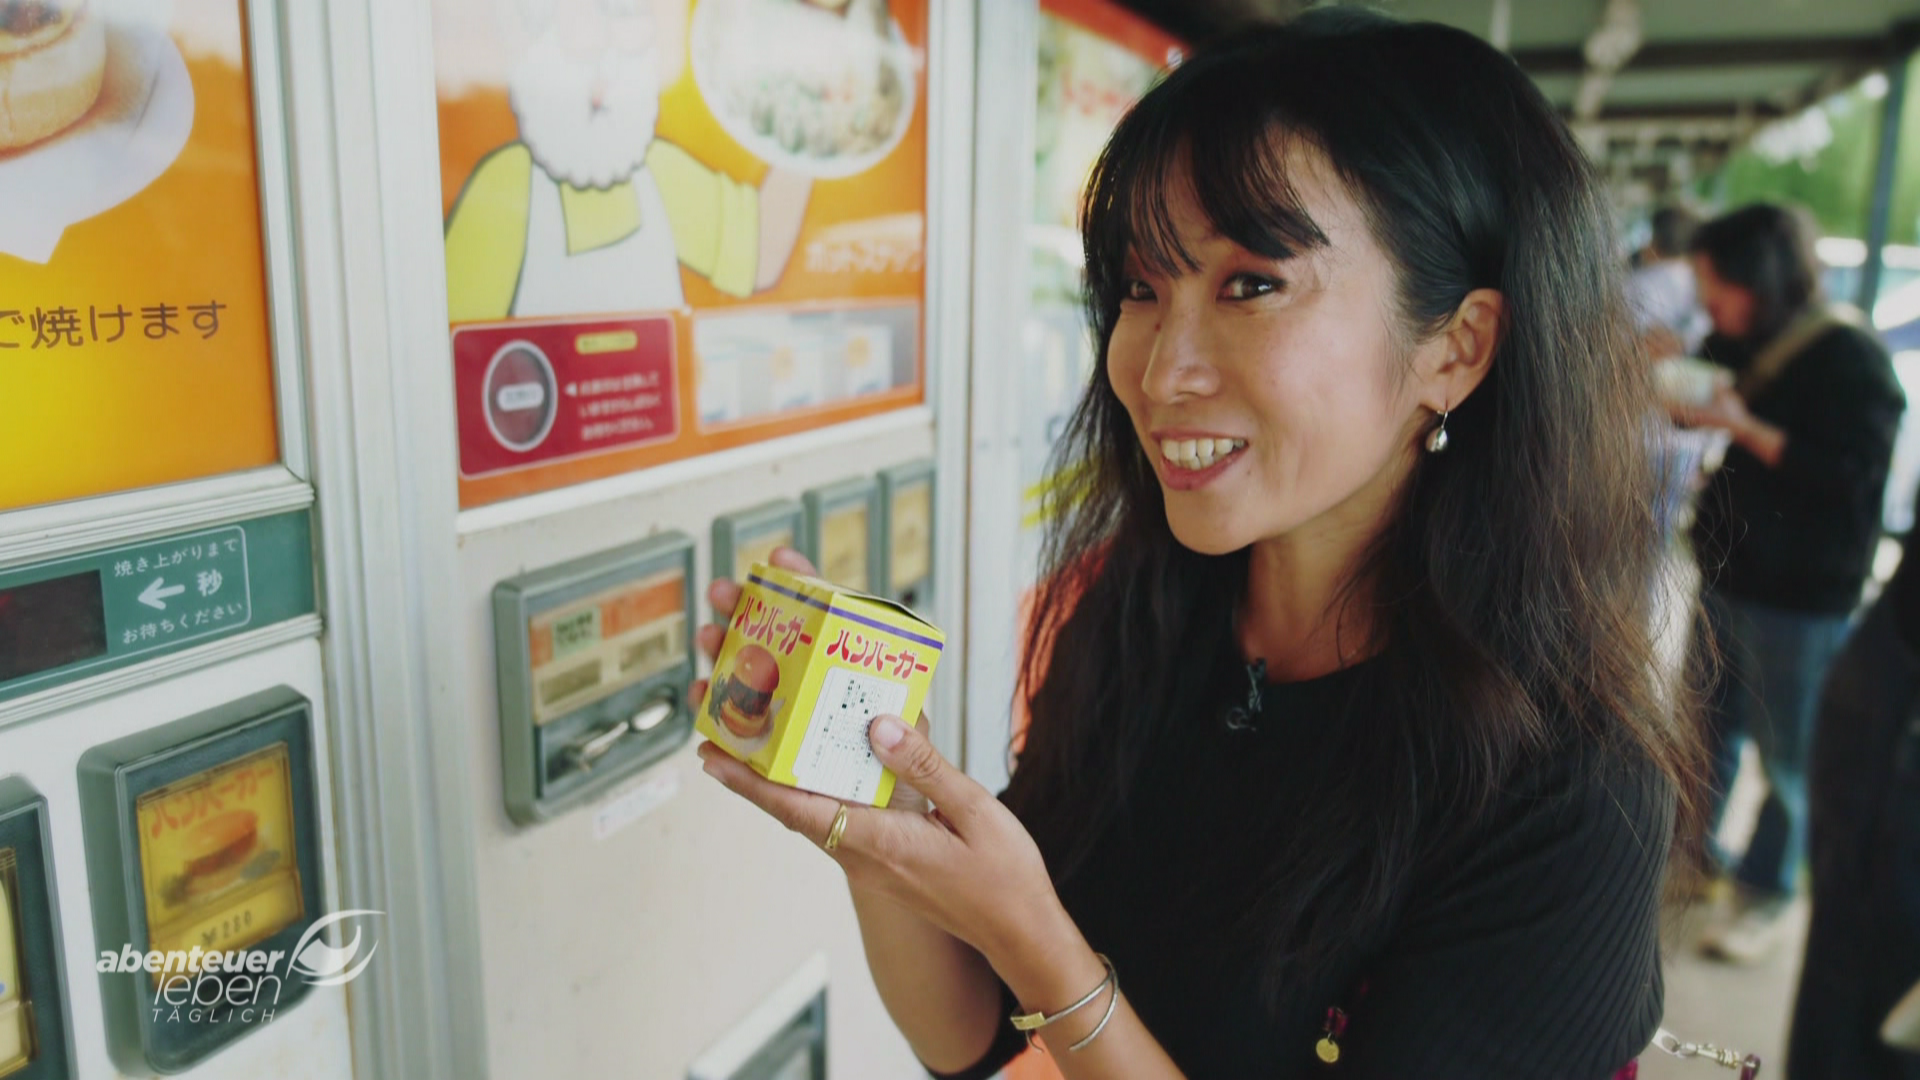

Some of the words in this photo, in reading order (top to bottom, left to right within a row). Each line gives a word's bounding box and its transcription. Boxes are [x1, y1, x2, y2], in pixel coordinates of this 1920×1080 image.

[197, 569, 223, 597] 秒
[123, 602, 242, 644] お待ちください
[734, 595, 813, 655] ハンバーガー
[826, 629, 929, 679] ハンバーガー
